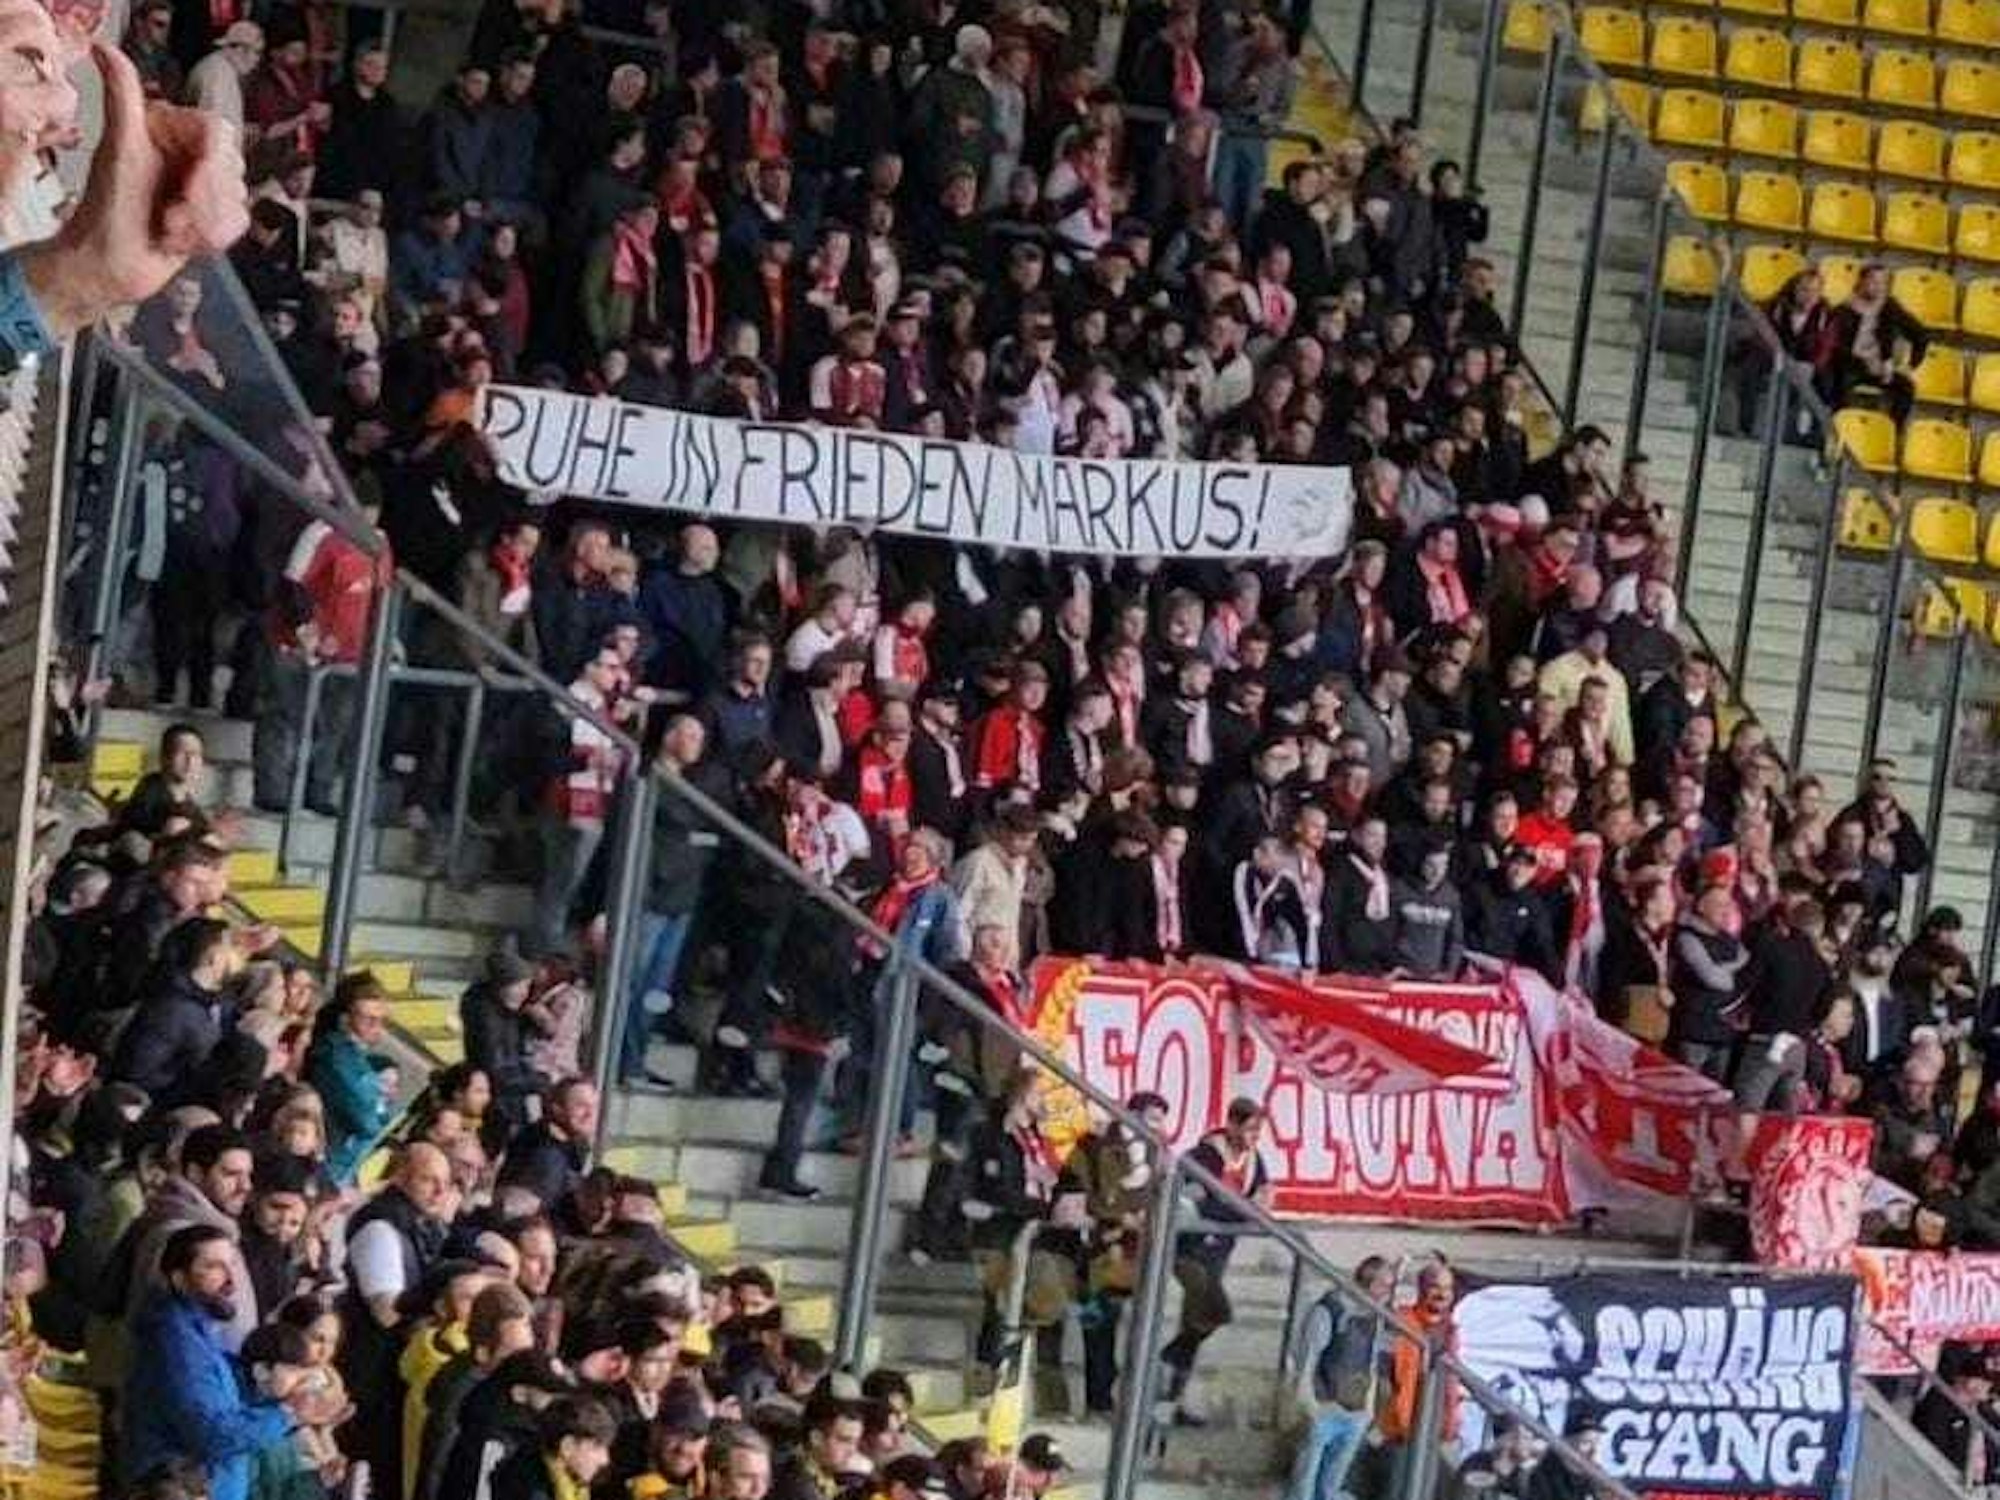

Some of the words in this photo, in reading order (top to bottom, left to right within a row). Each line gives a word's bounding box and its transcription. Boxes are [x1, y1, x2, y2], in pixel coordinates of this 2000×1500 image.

[482, 388, 643, 498] RUHE
[664, 414, 721, 508] IN
[734, 422, 993, 538] FRIEDEN
[1012, 453, 1271, 552] MARKUS!
[1597, 1408, 1827, 1487] GÄNG
